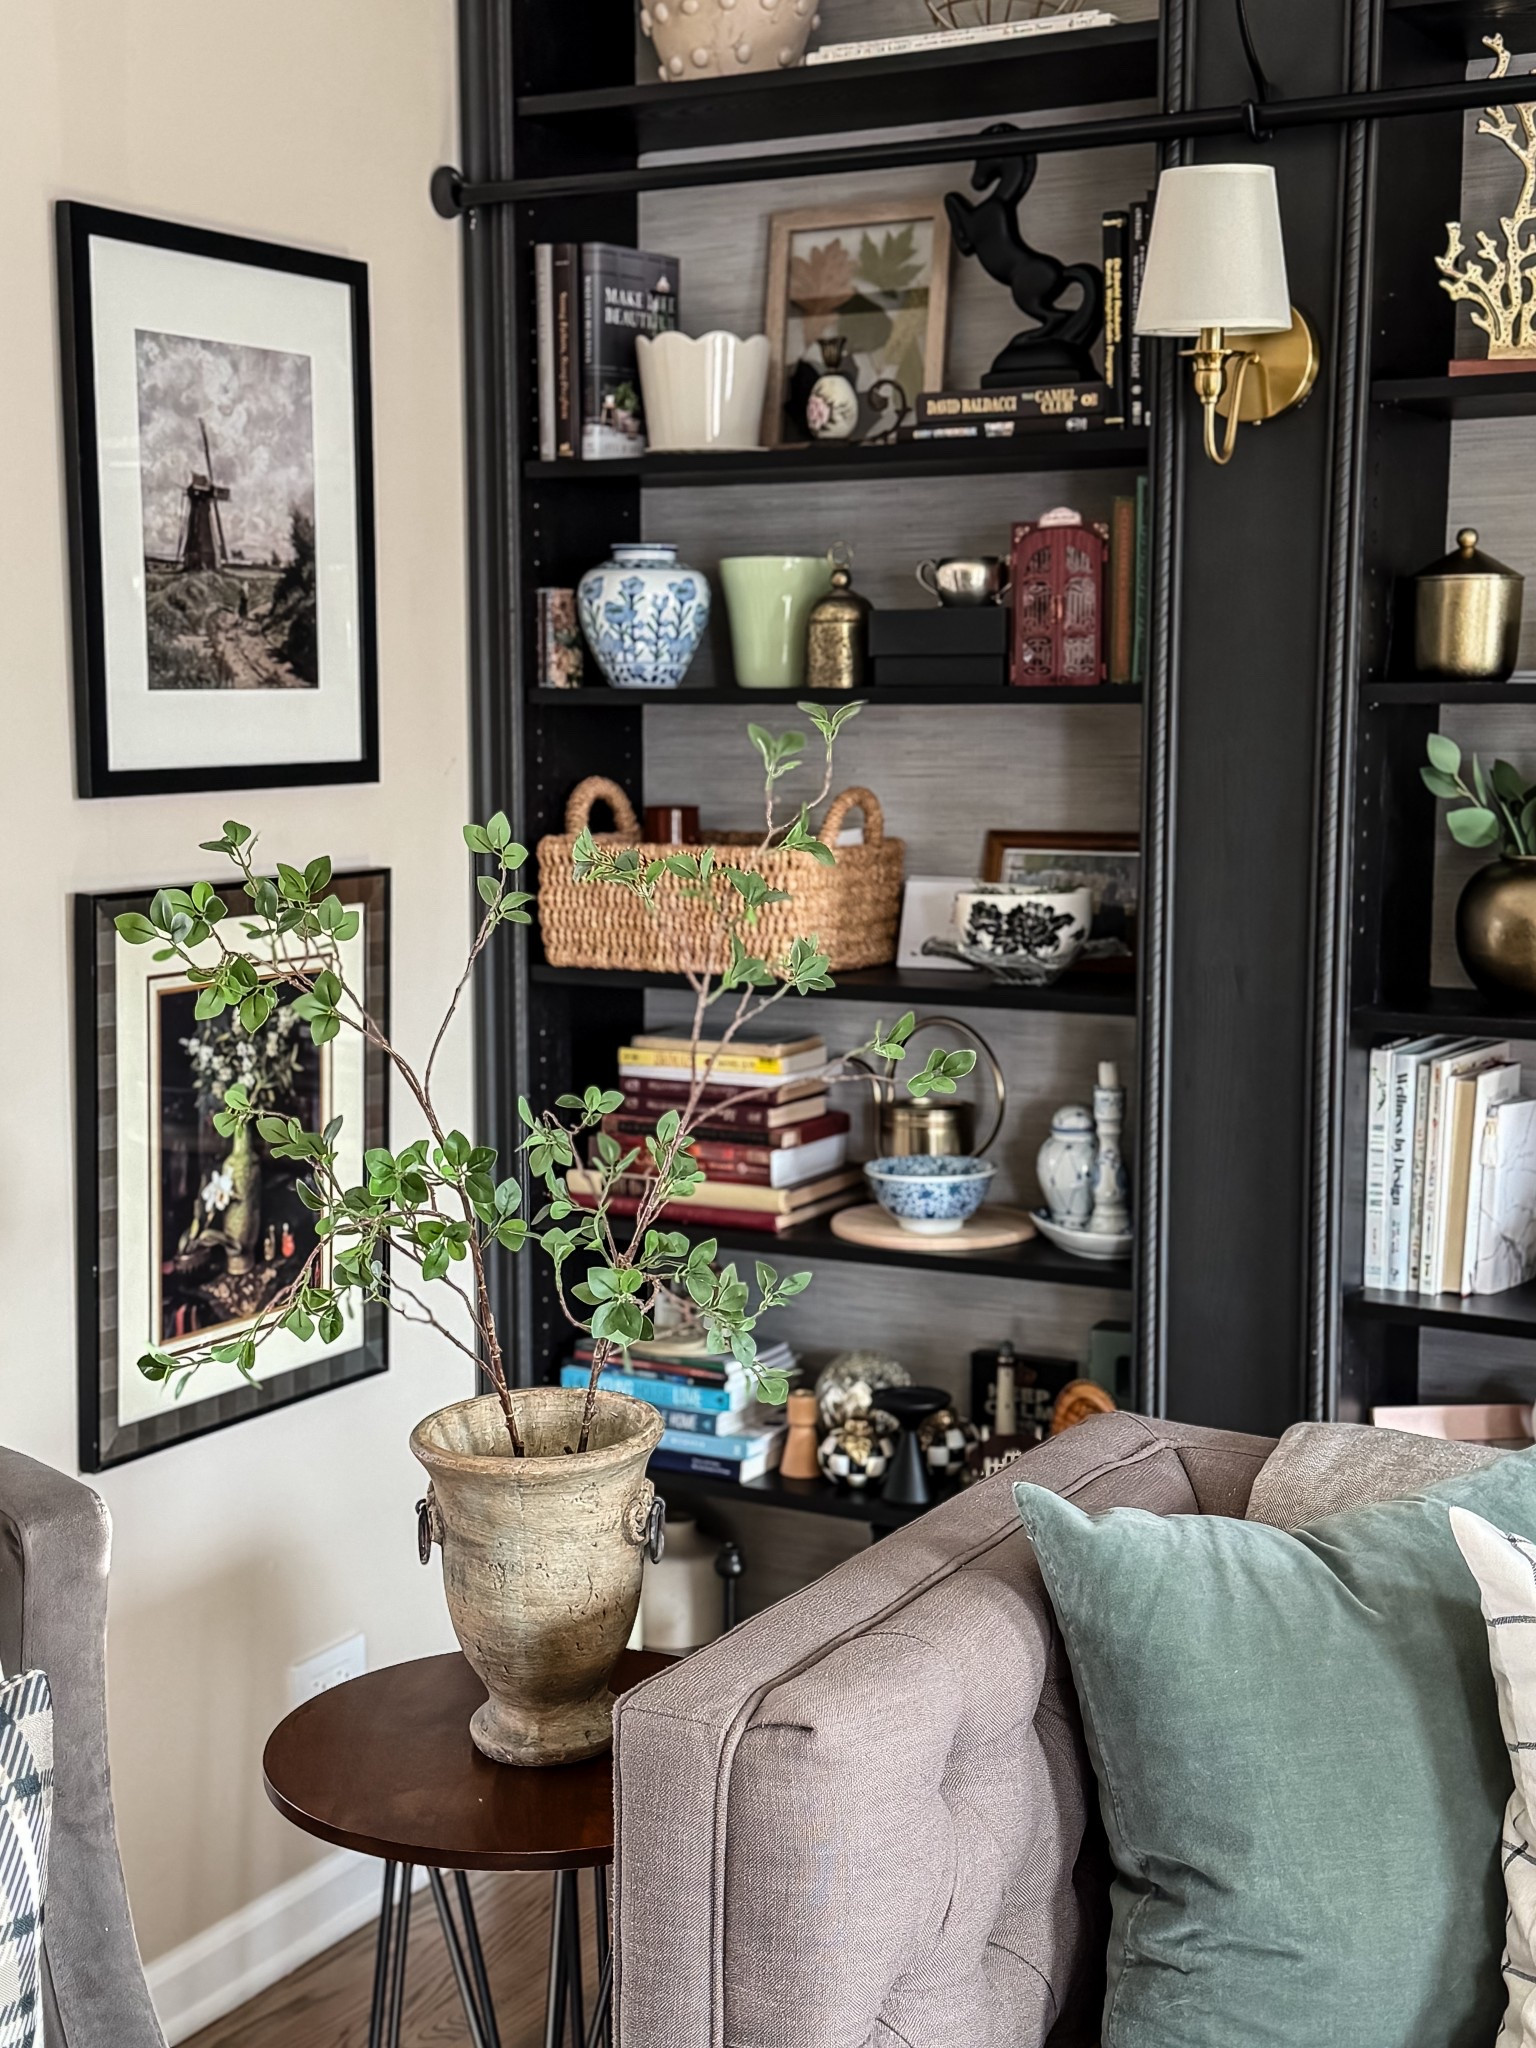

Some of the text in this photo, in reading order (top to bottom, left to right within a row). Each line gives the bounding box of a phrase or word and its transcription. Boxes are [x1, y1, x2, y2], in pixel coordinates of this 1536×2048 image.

[604, 286, 644, 309] MAKE
[1130, 352, 1140, 378] BOAT
[926, 399, 961, 416] DAVID
[961, 395, 1018, 414] BALDACCI
[1034, 388, 1077, 403] CAMEL
[1040, 400, 1074, 414] CLUB
[1394, 1072, 1408, 1134] Wellness
[1391, 1138, 1406, 1152] by
[1391, 1158, 1405, 1207] Design
